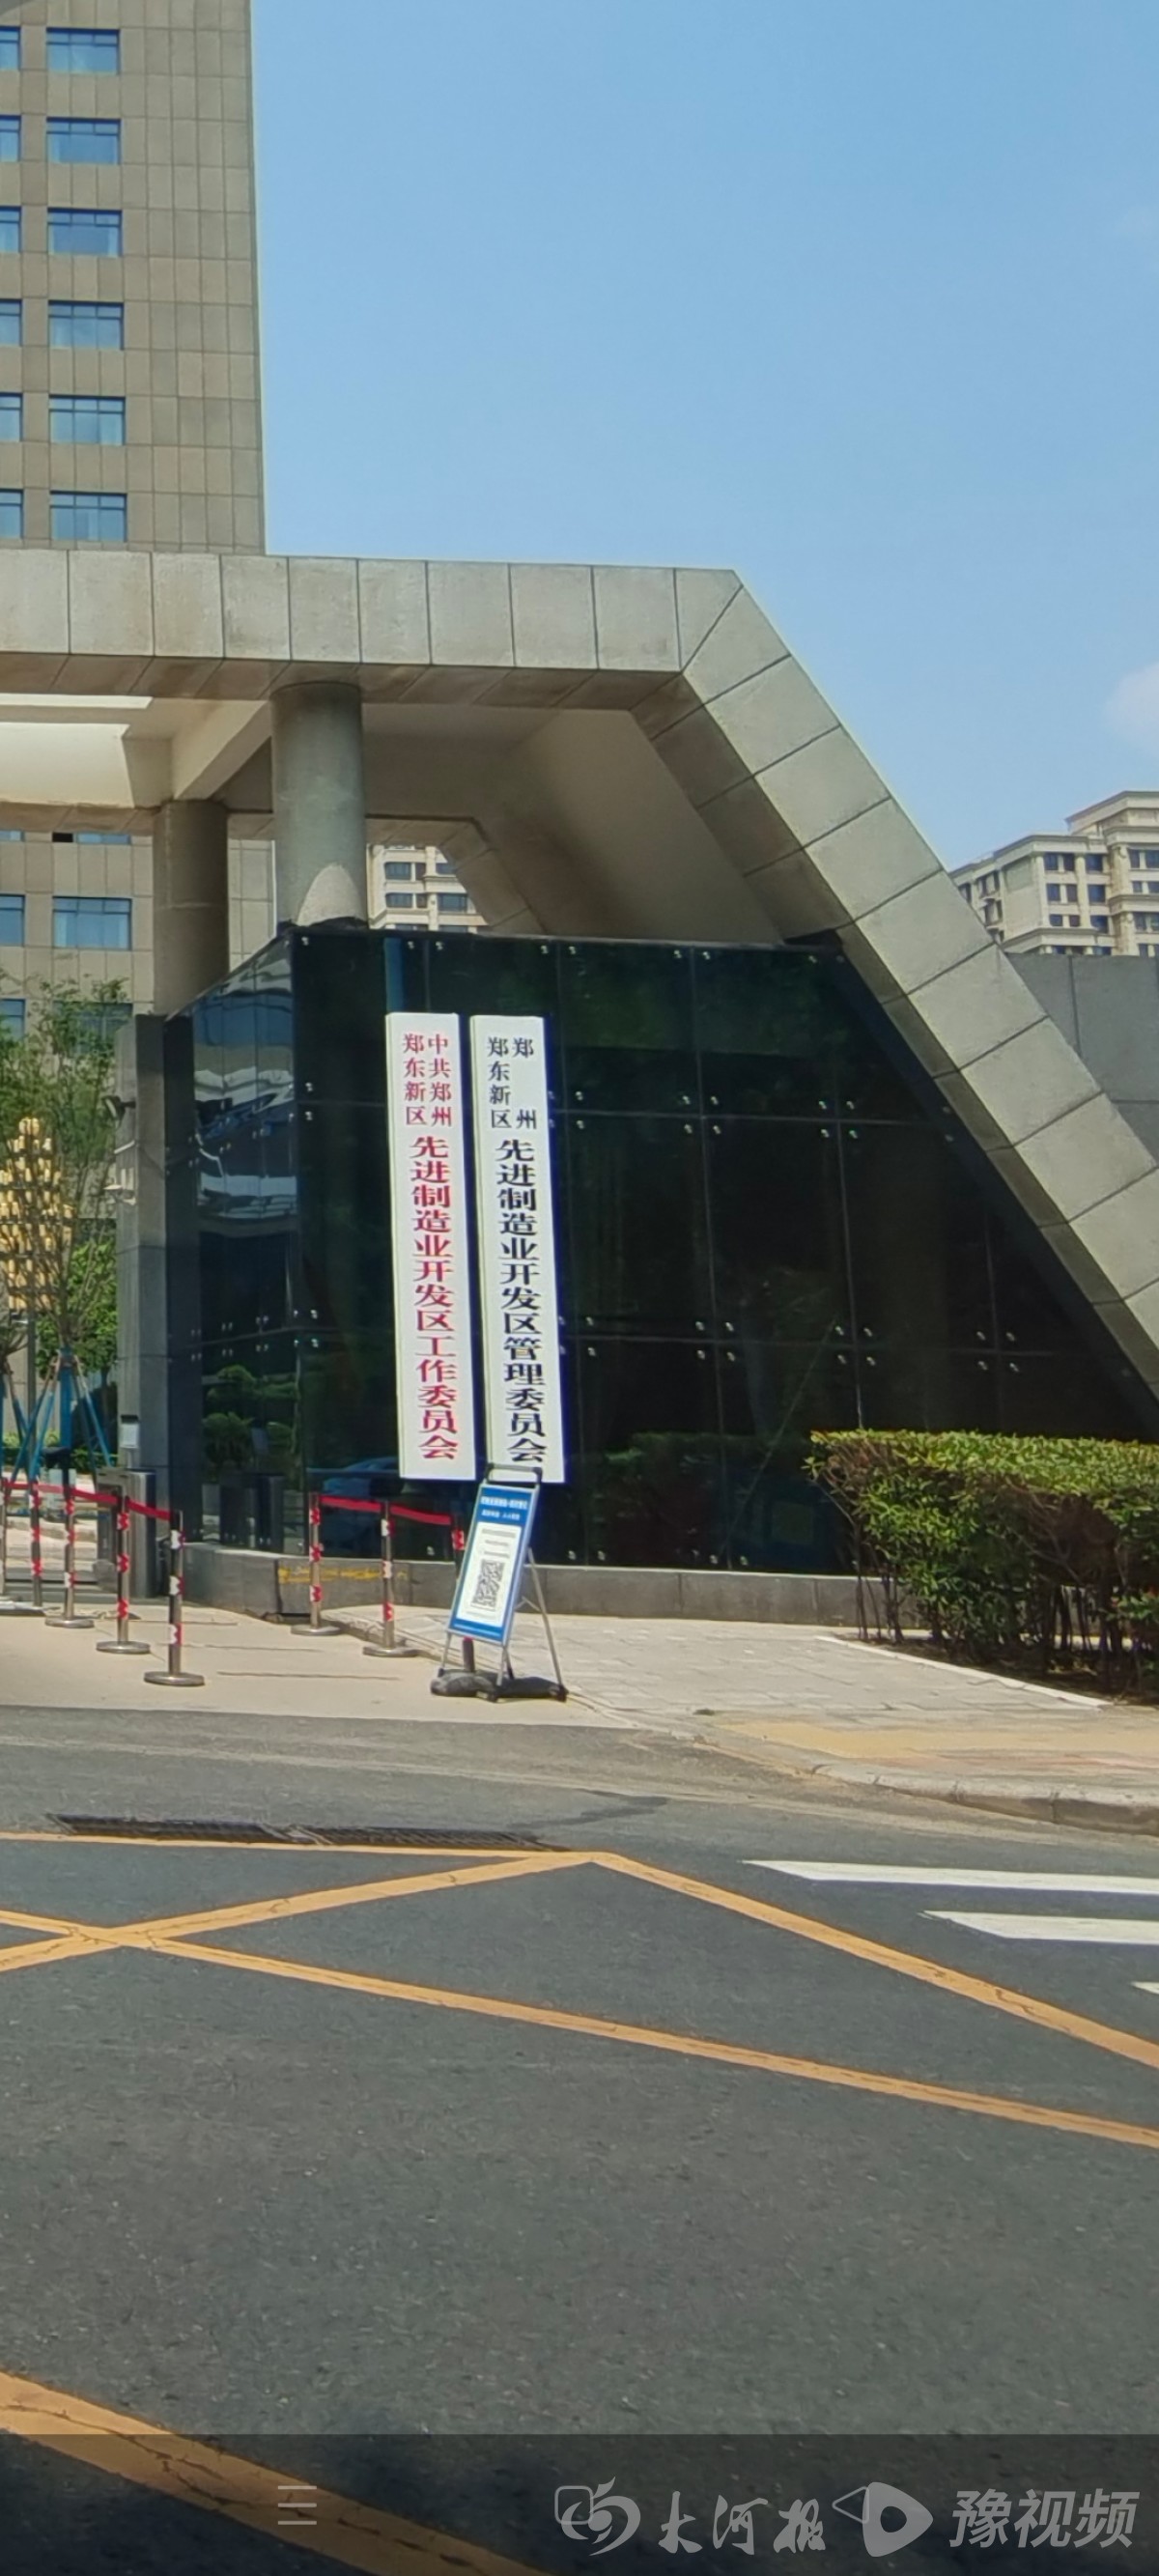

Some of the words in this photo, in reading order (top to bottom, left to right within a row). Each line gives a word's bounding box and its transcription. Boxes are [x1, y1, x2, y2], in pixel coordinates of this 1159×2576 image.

[402, 1033, 427, 1125] 郑东新区
[428, 1033, 452, 1127] 中共郑州
[487, 1036, 512, 1129] 郑东新区
[409, 1136, 458, 1459] 先进制造业开发区工作委员会
[495, 1139, 548, 1462] 先进制造业开发区管理委员会
